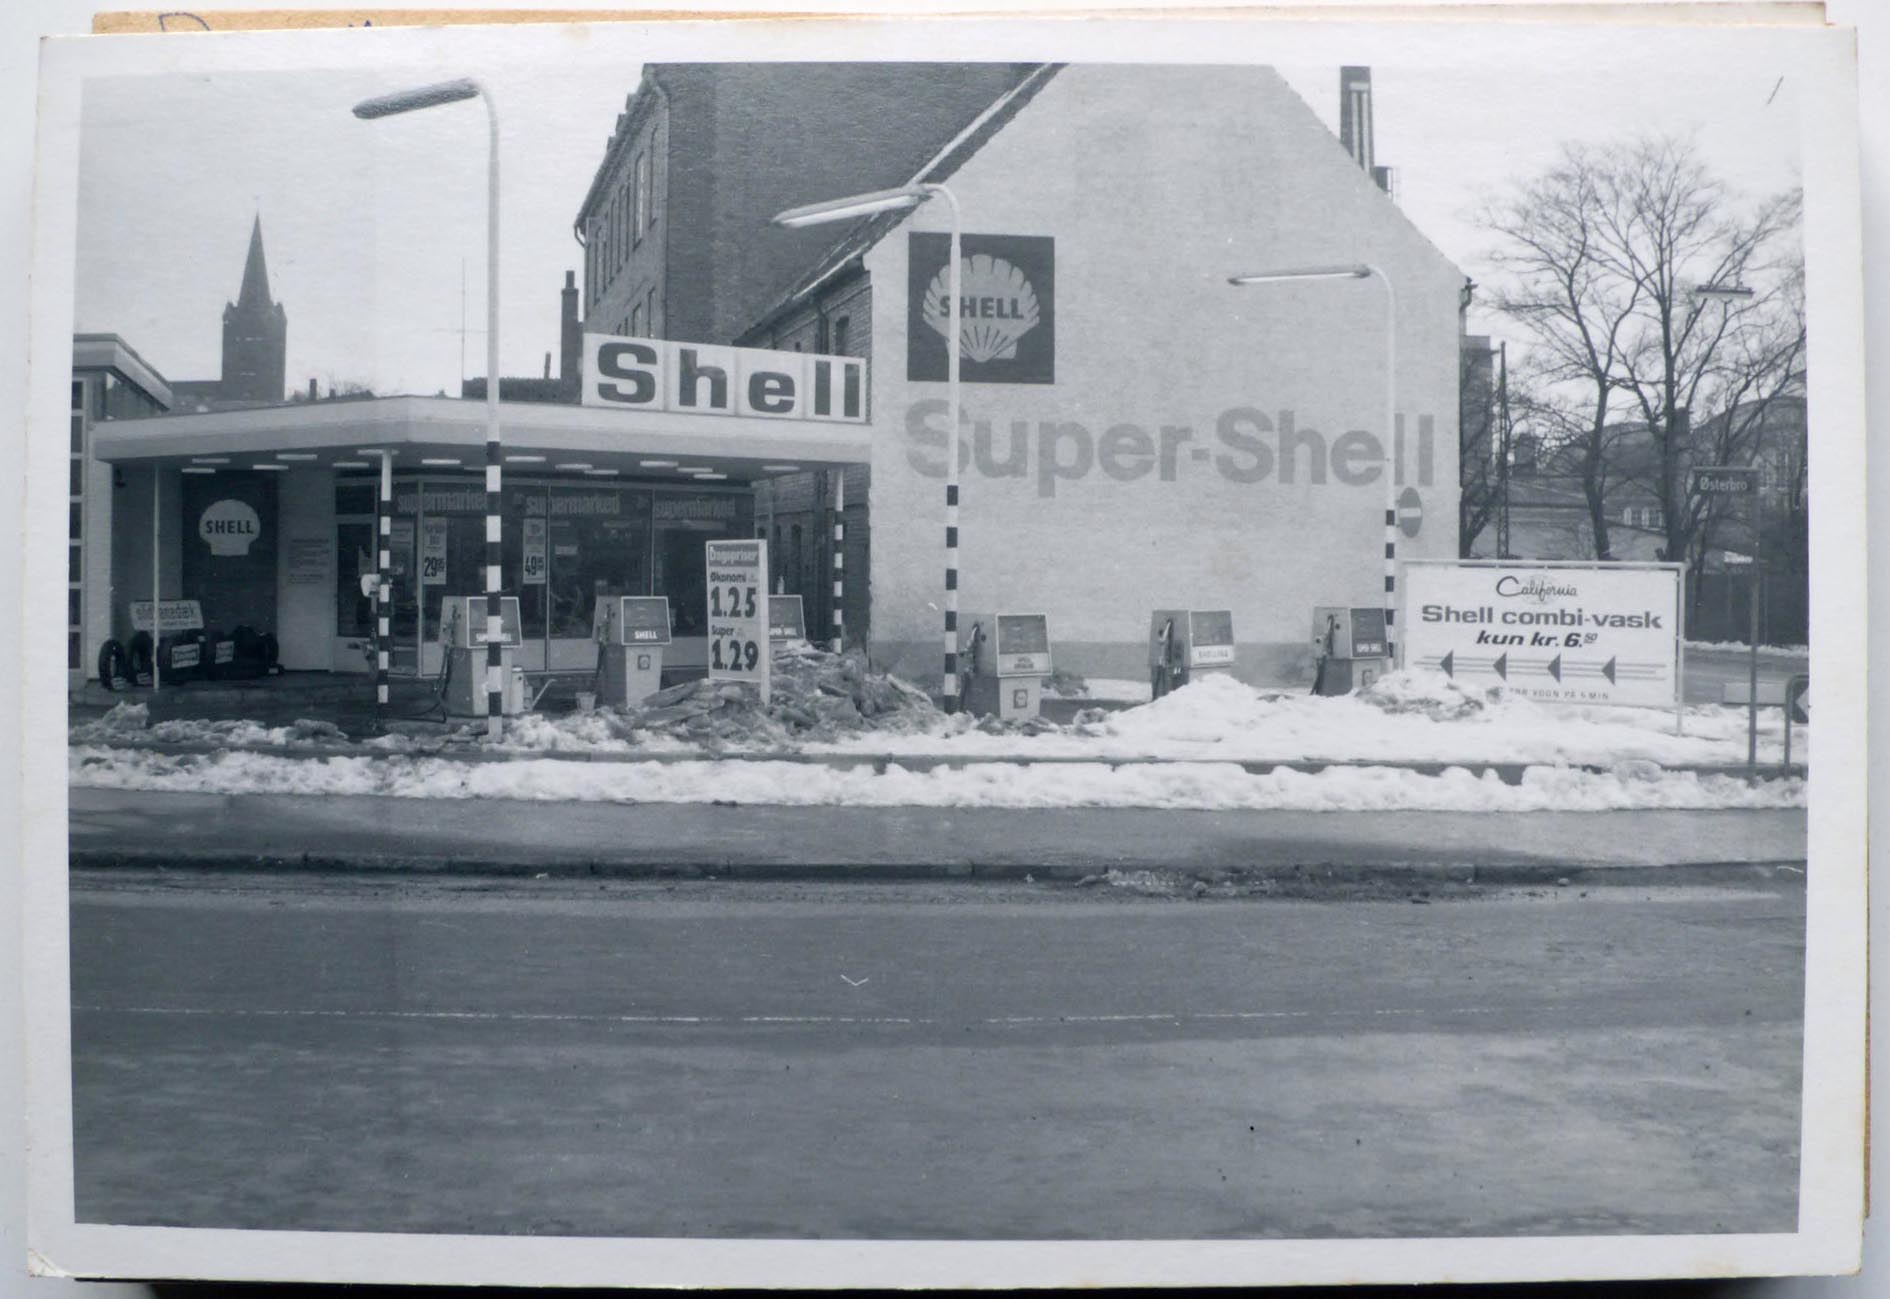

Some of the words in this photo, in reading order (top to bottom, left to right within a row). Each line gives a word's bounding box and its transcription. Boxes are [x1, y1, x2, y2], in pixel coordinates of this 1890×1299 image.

[939, 295, 1024, 320] SHELL
[597, 342, 860, 418] Shell
[904, 398, 1435, 499] Super-Shell
[1700, 476, 1748, 491] Østerbro
[205, 520, 254, 535] SHELL
[1495, 575, 1578, 602] California
[711, 586, 757, 618] 1.25
[1421, 604, 1494, 624] Shell
[1501, 607, 1664, 630] combi-vask
[634, 630, 658, 640] SHELL
[711, 625, 735, 638] Super
[1475, 629, 1525, 646] kun
[1529, 632, 1560, 648] kr.
[711, 639, 759, 672] 1.29
